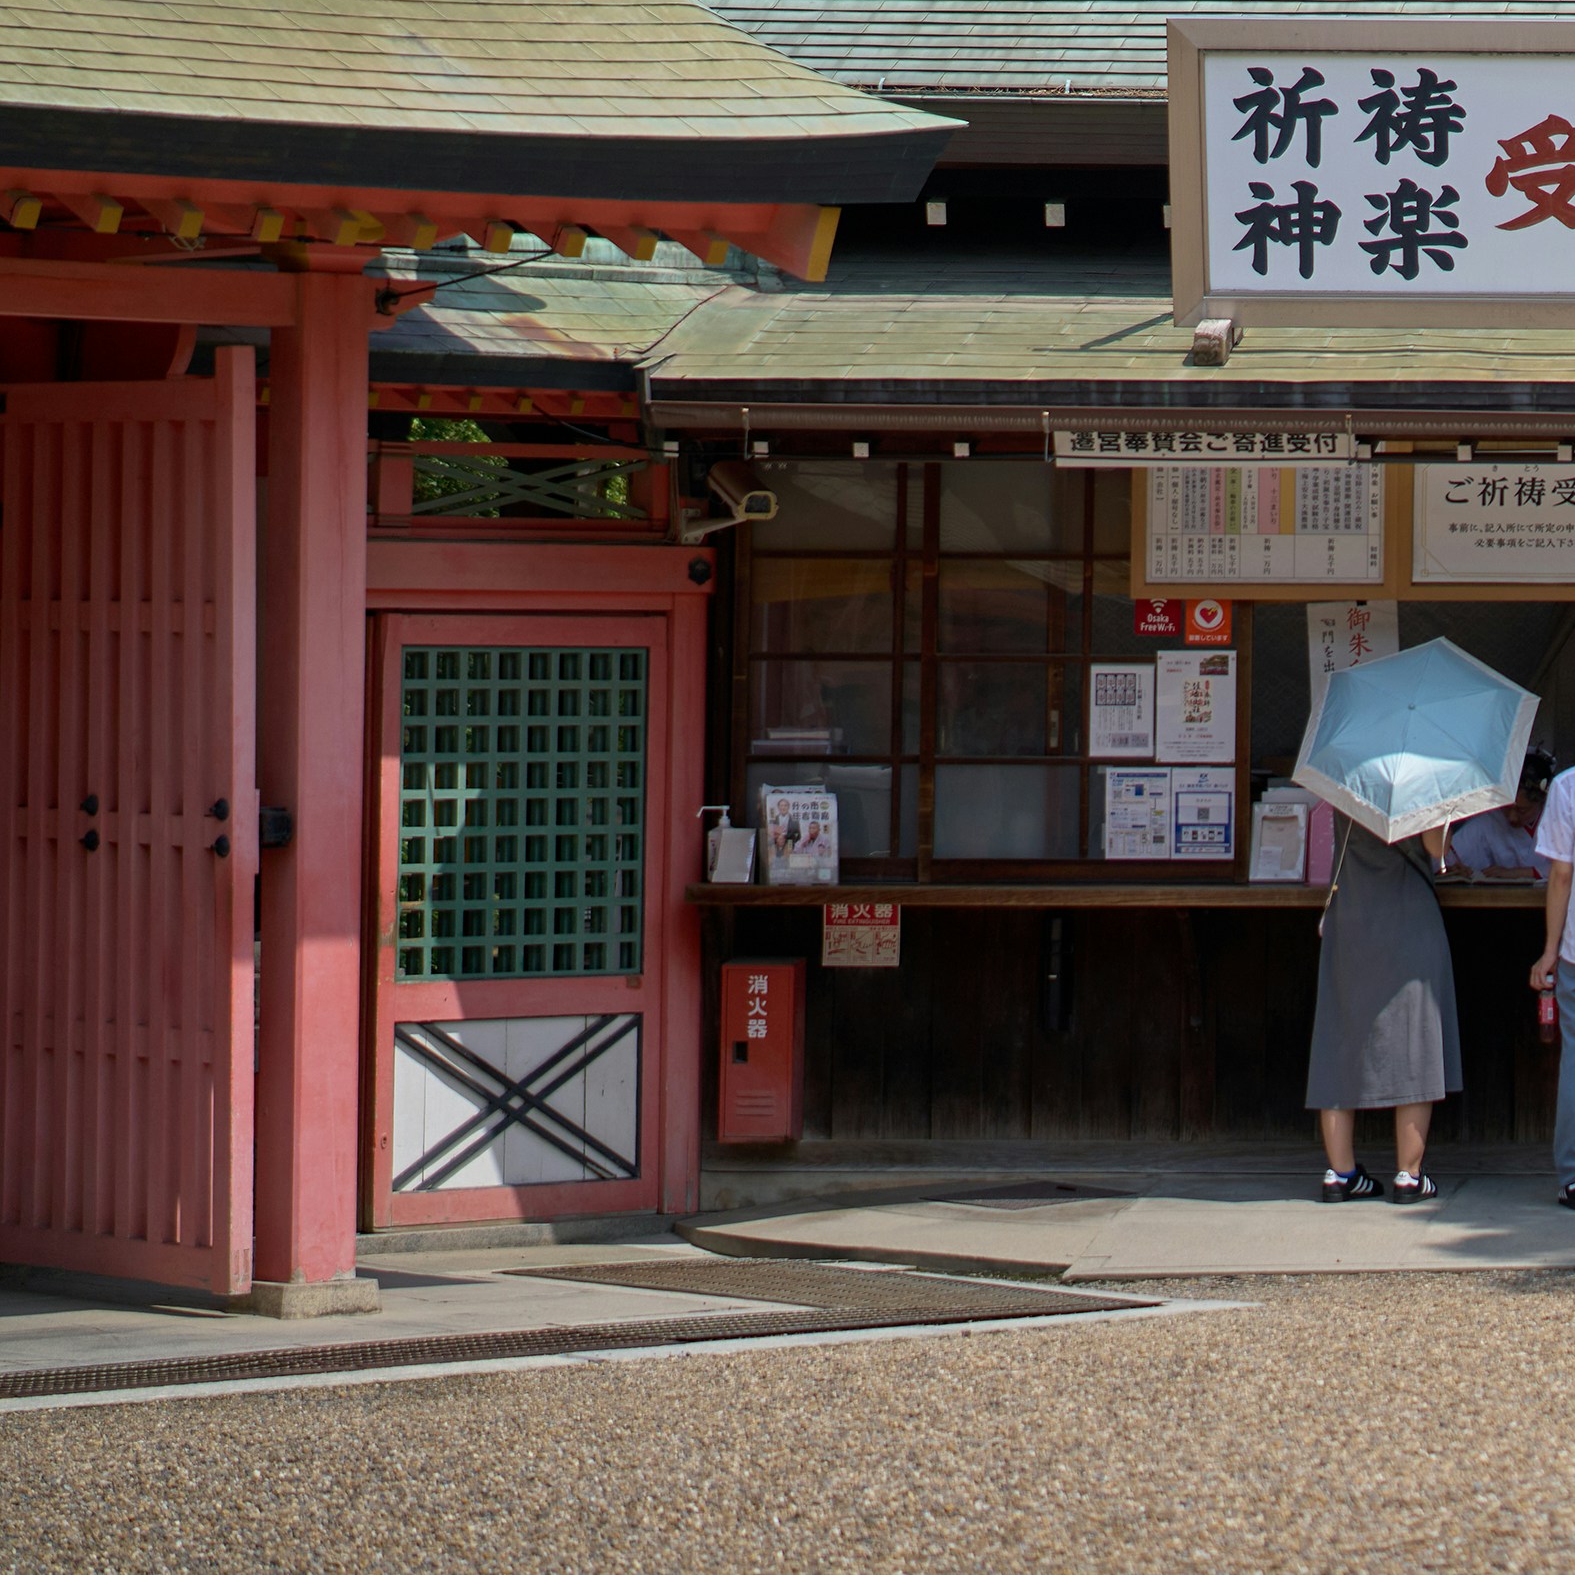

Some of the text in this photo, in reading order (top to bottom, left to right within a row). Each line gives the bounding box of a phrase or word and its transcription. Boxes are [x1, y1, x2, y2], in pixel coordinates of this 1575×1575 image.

[1232, 65, 1468, 169] 祈祷
[1232, 178, 1470, 282] 神楽
[1147, 613, 1169, 623] Osaka
[1346, 608, 1373, 667] 御朱
[830, 903, 893, 918] 消火器
[747, 974, 768, 1039] 消火器
